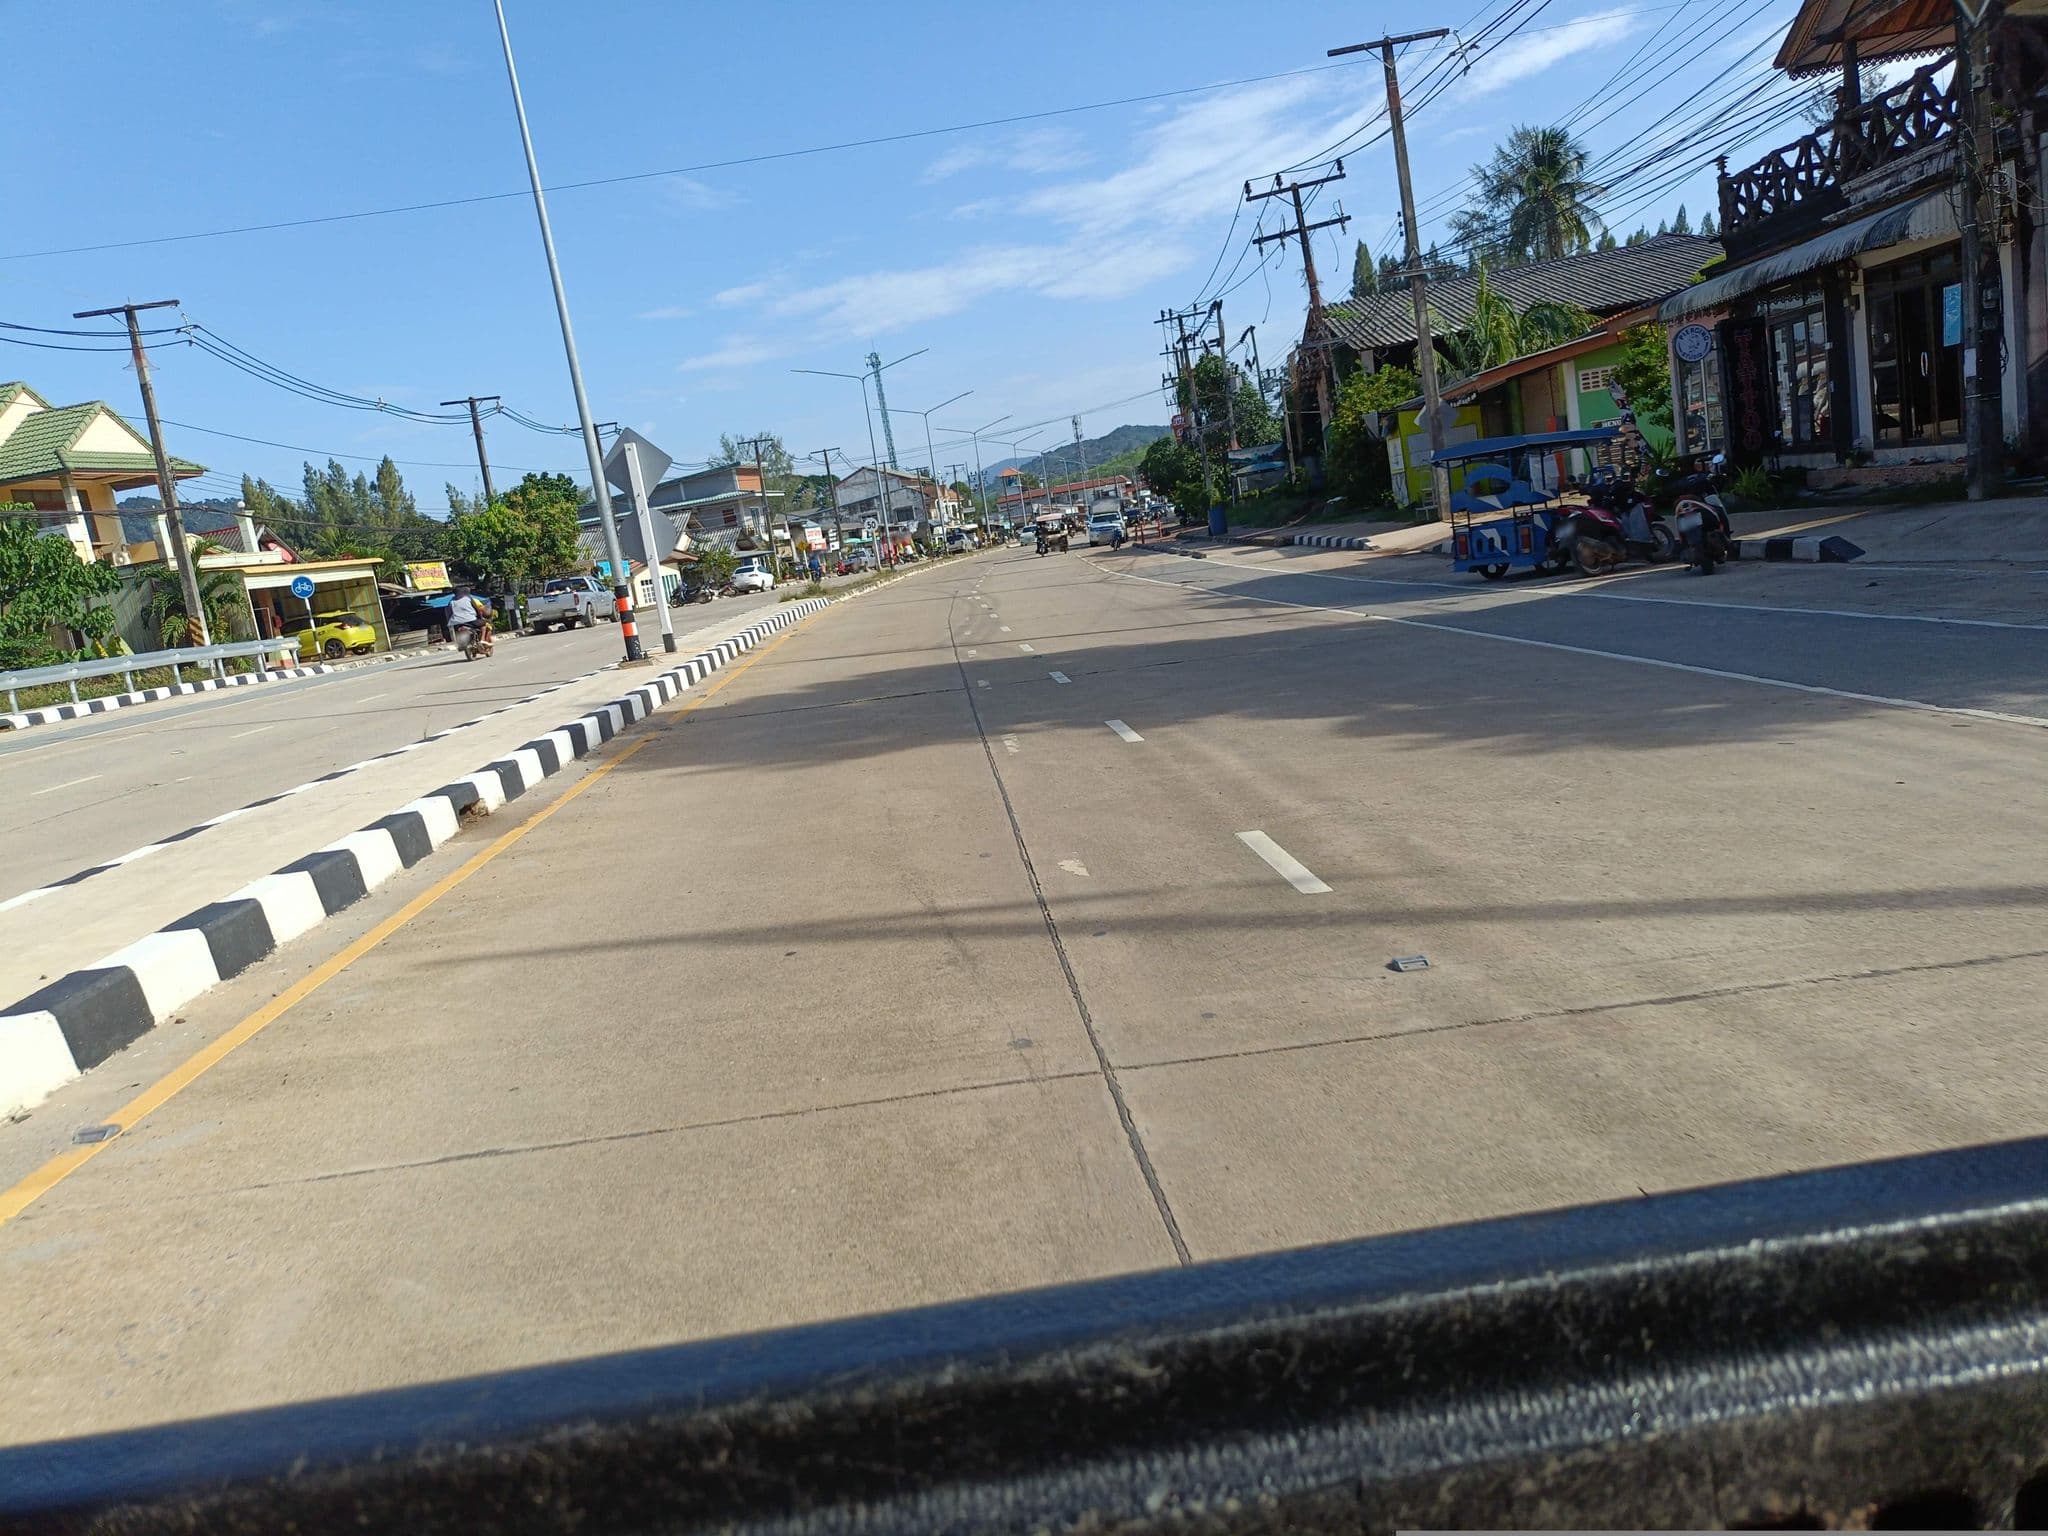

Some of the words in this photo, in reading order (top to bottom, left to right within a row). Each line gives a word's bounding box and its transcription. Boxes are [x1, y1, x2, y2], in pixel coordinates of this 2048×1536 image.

[1679, 327, 1710, 341] PIERCING
[1601, 419, 1622, 428] MENU
[866, 521, 876, 530] 50
